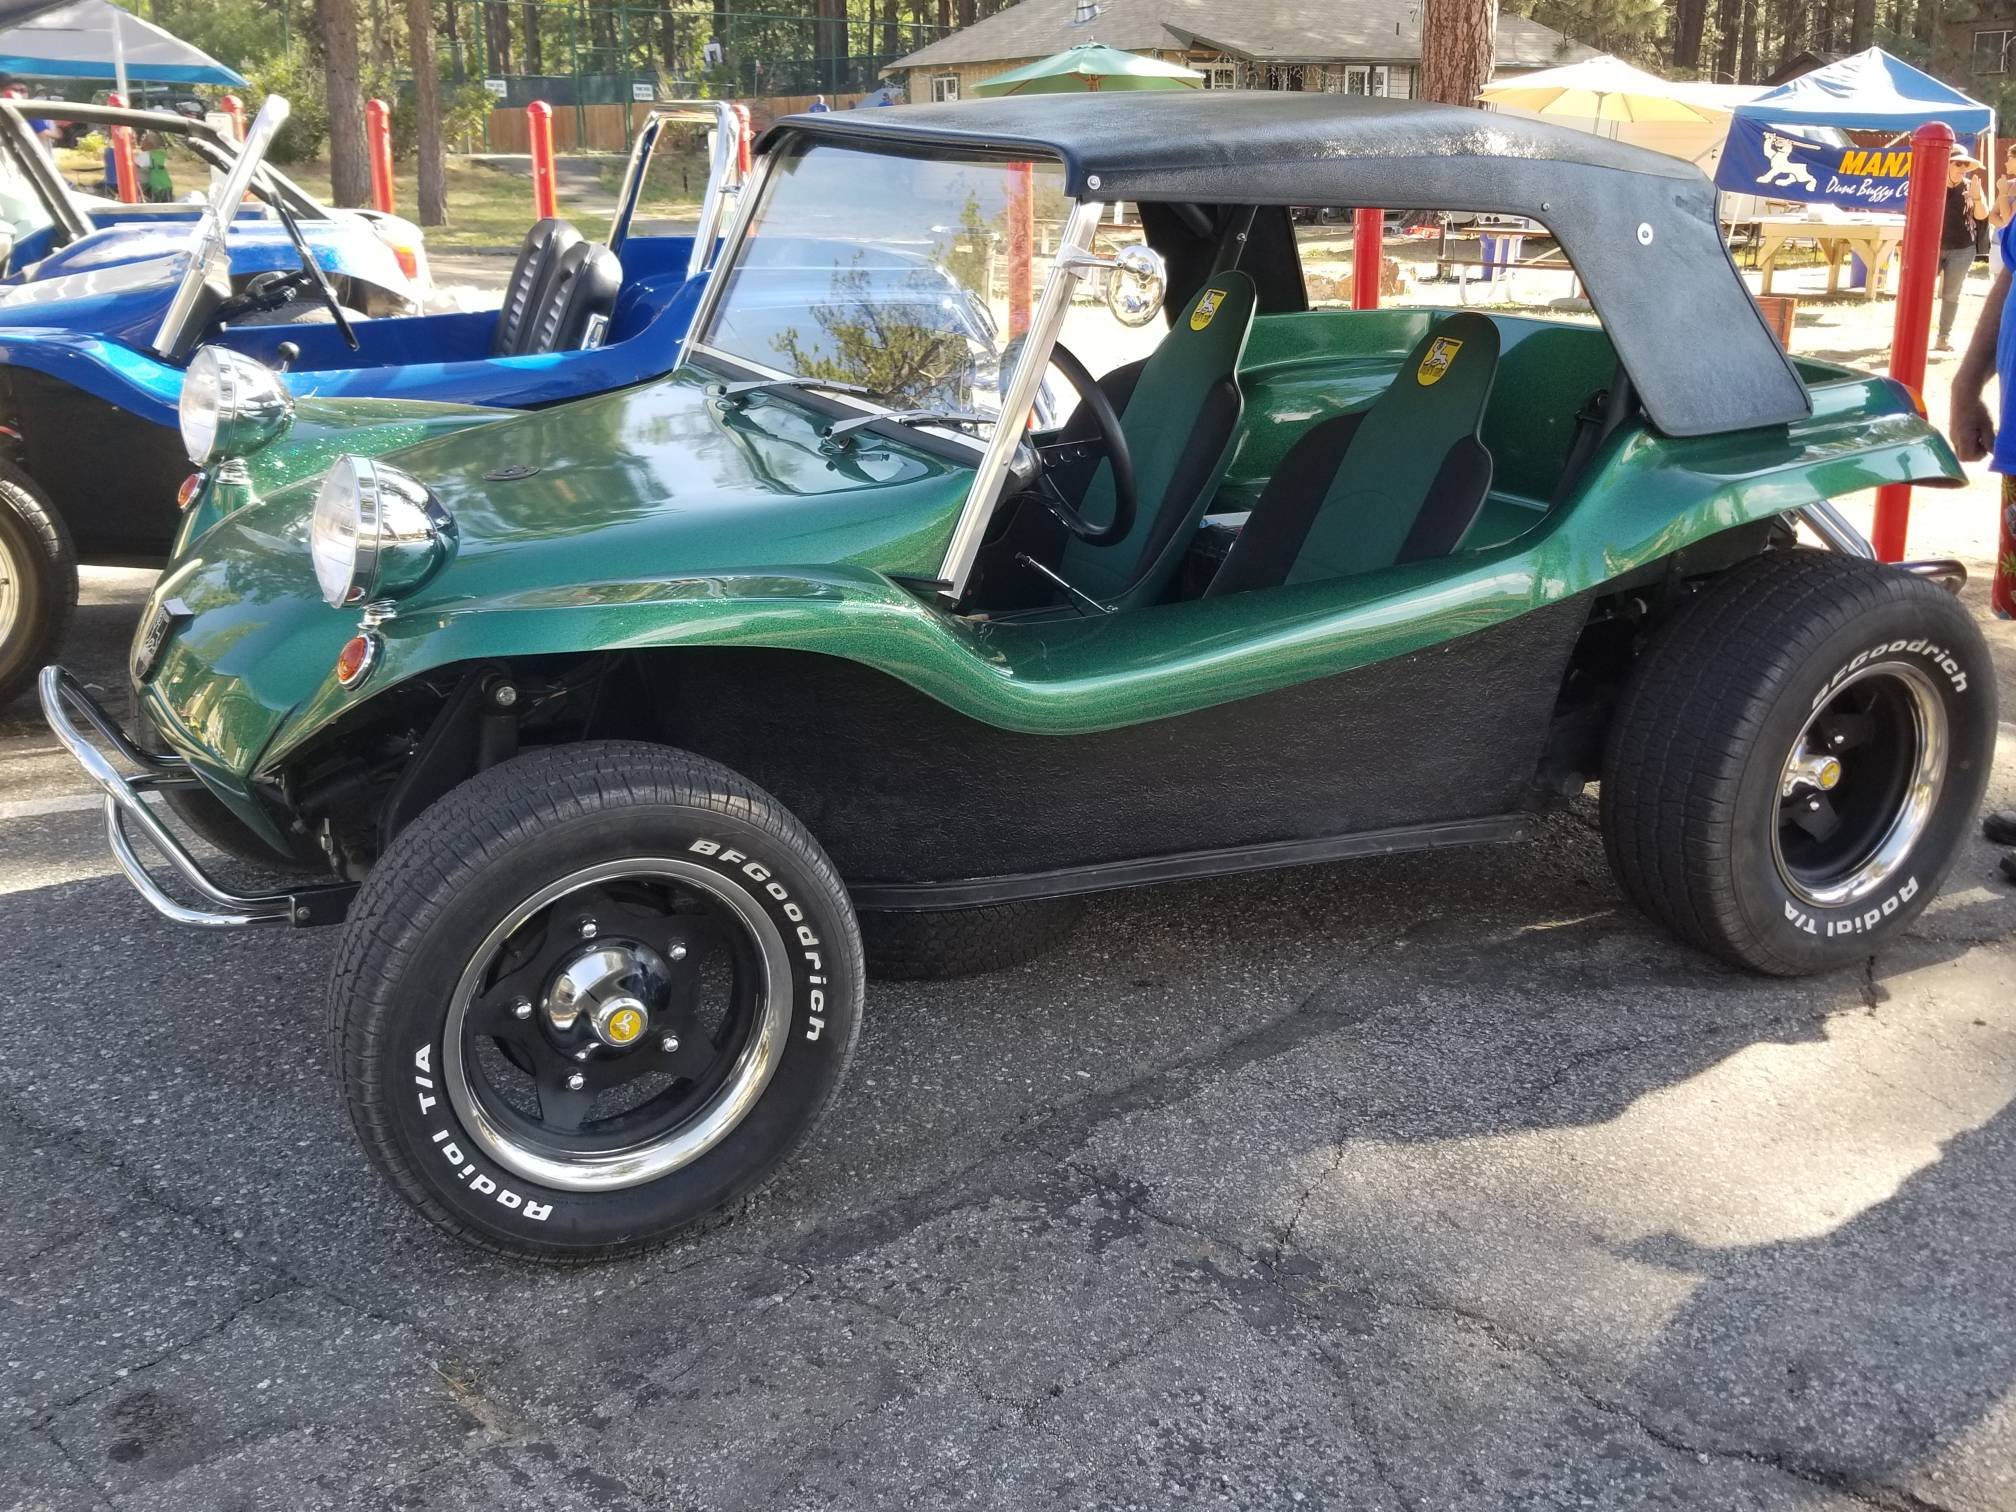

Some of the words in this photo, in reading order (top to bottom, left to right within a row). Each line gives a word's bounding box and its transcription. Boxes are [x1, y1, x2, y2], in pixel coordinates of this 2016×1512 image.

[1825, 175, 1857, 194] Dune
[1856, 178, 1895, 203] Buggy
[1838, 150, 1912, 177] MANX
[1784, 900, 1817, 934] T/A
[1826, 876, 1919, 937] Radial
[688, 839, 827, 1041] BFGoodrich
[415, 1043, 437, 1116] T/A
[431, 1129, 554, 1222] Radial
